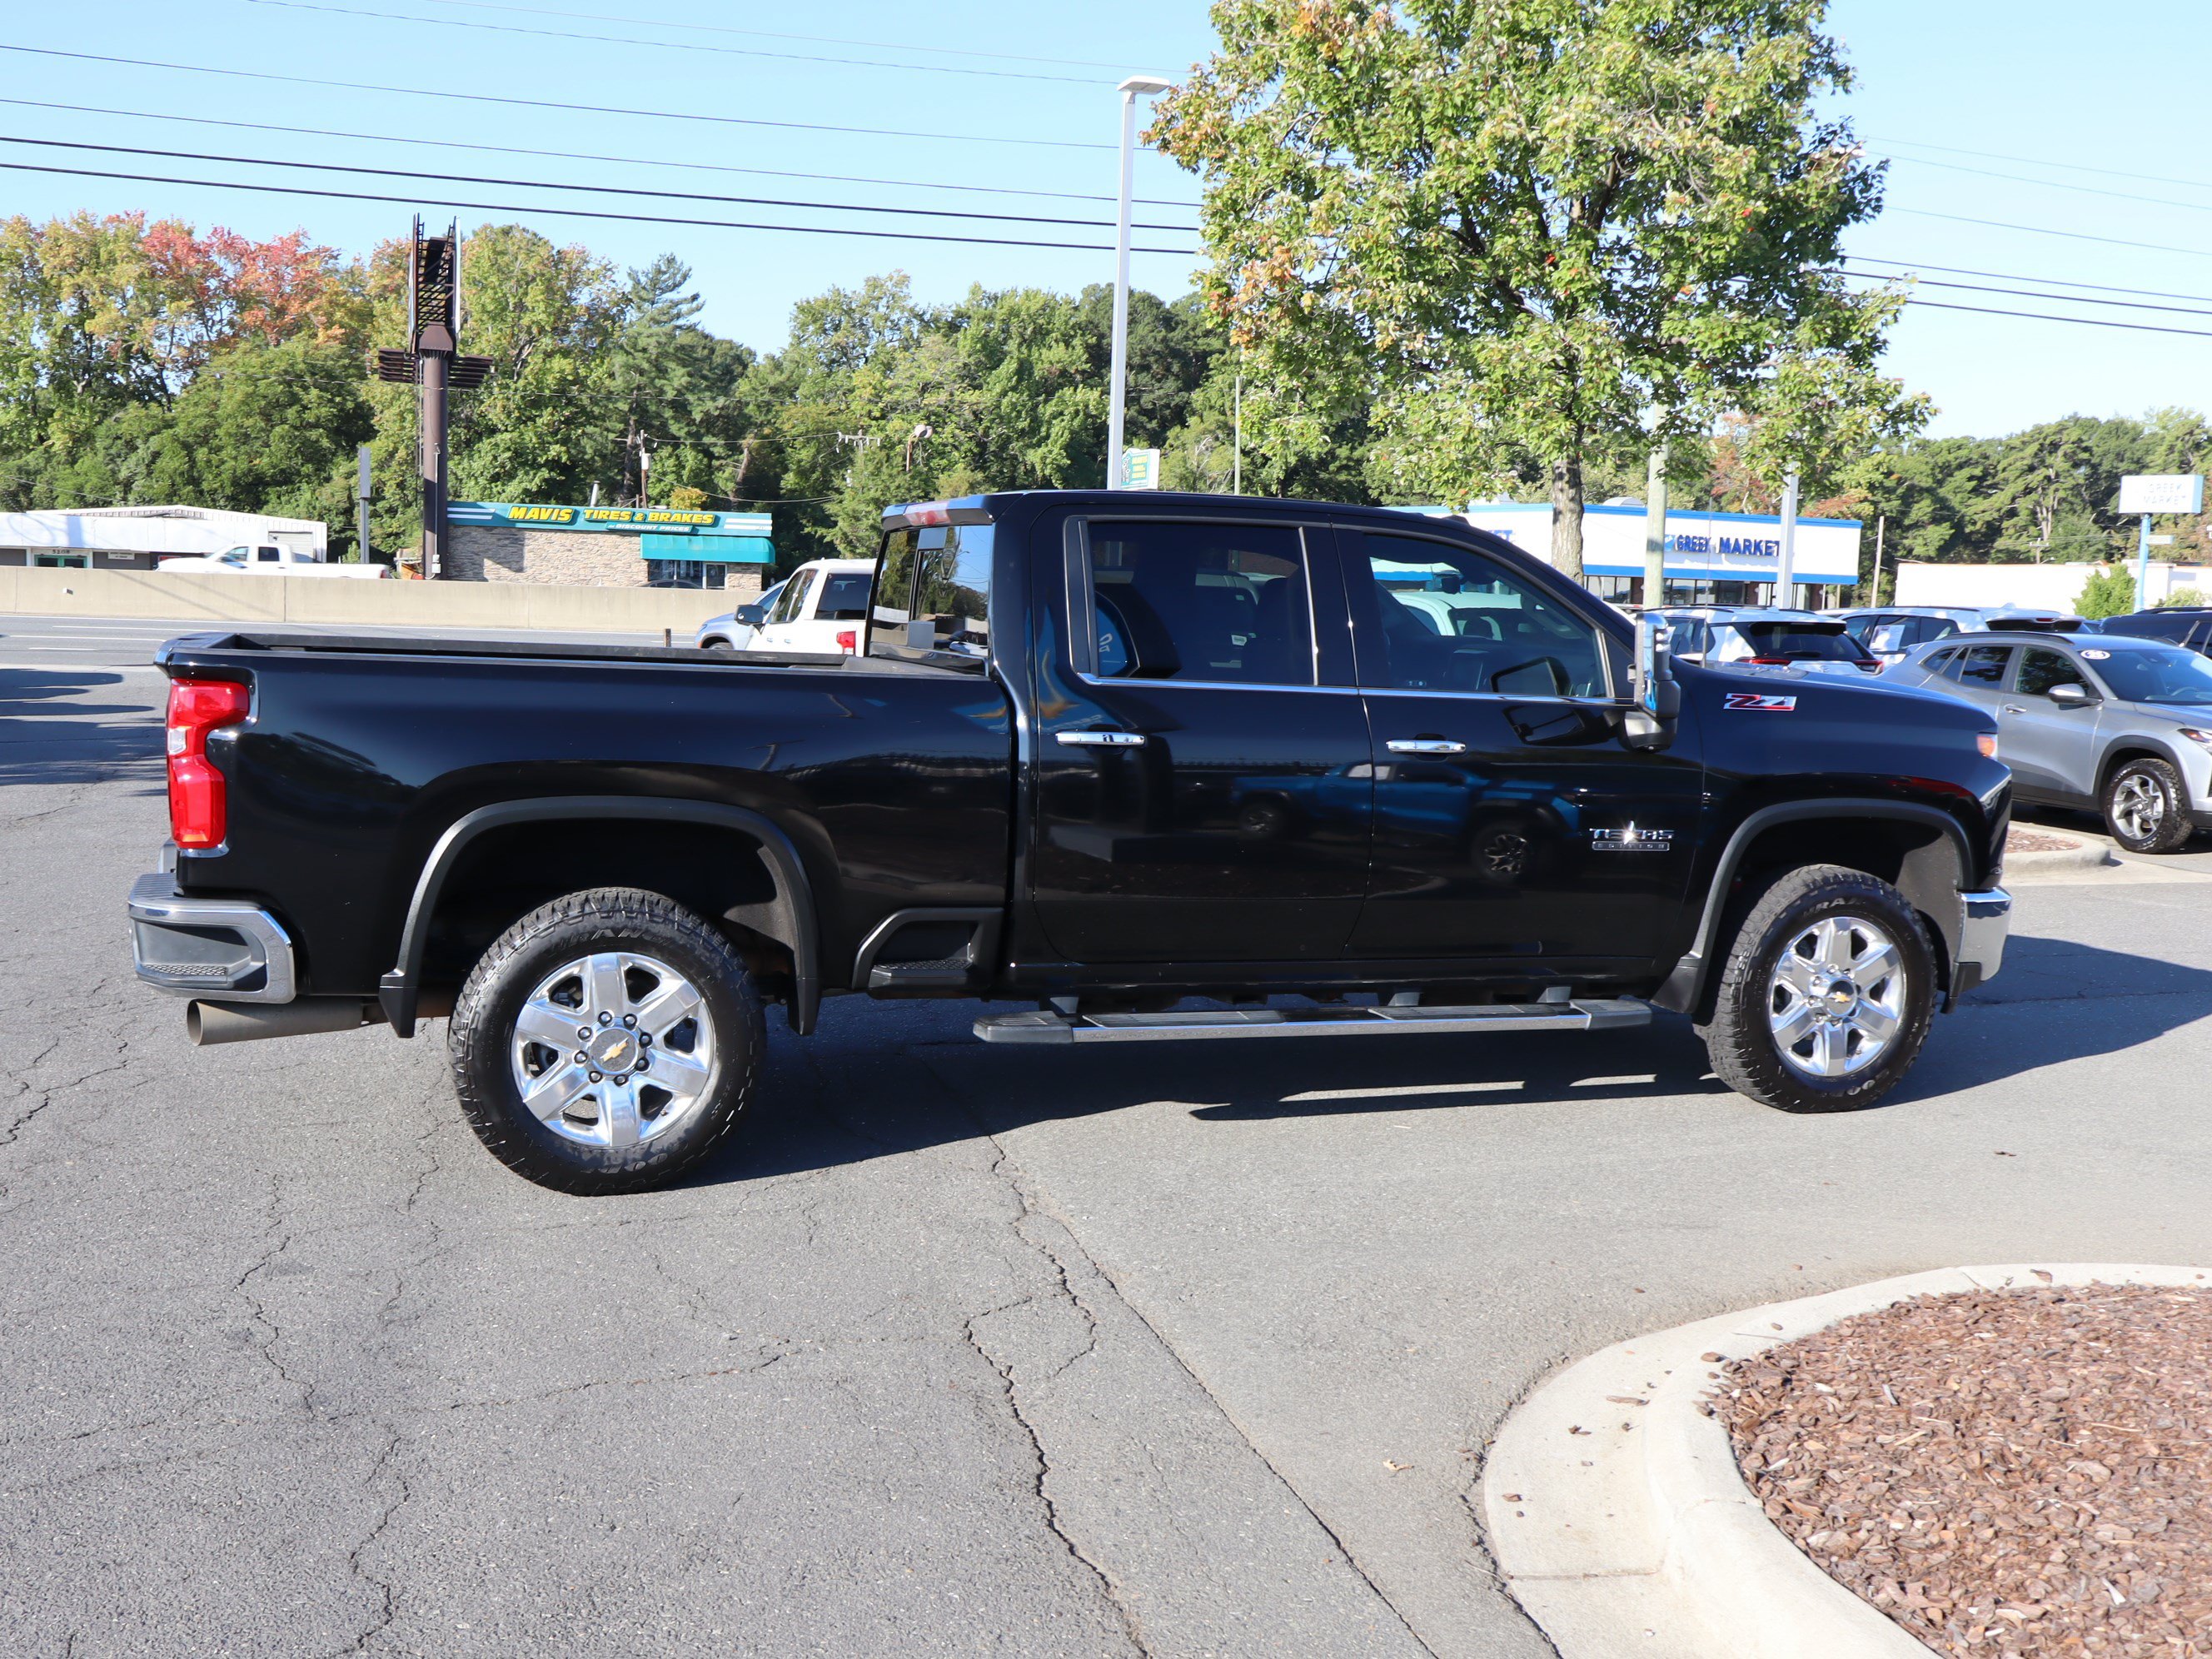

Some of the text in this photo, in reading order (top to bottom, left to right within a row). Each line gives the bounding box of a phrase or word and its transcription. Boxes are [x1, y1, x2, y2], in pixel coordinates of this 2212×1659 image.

[507, 506, 715, 524] MAVIS TIRES & BRAKES
[1676, 535, 1781, 556] GREEK MARKET
[1723, 693, 1797, 711] Z71
